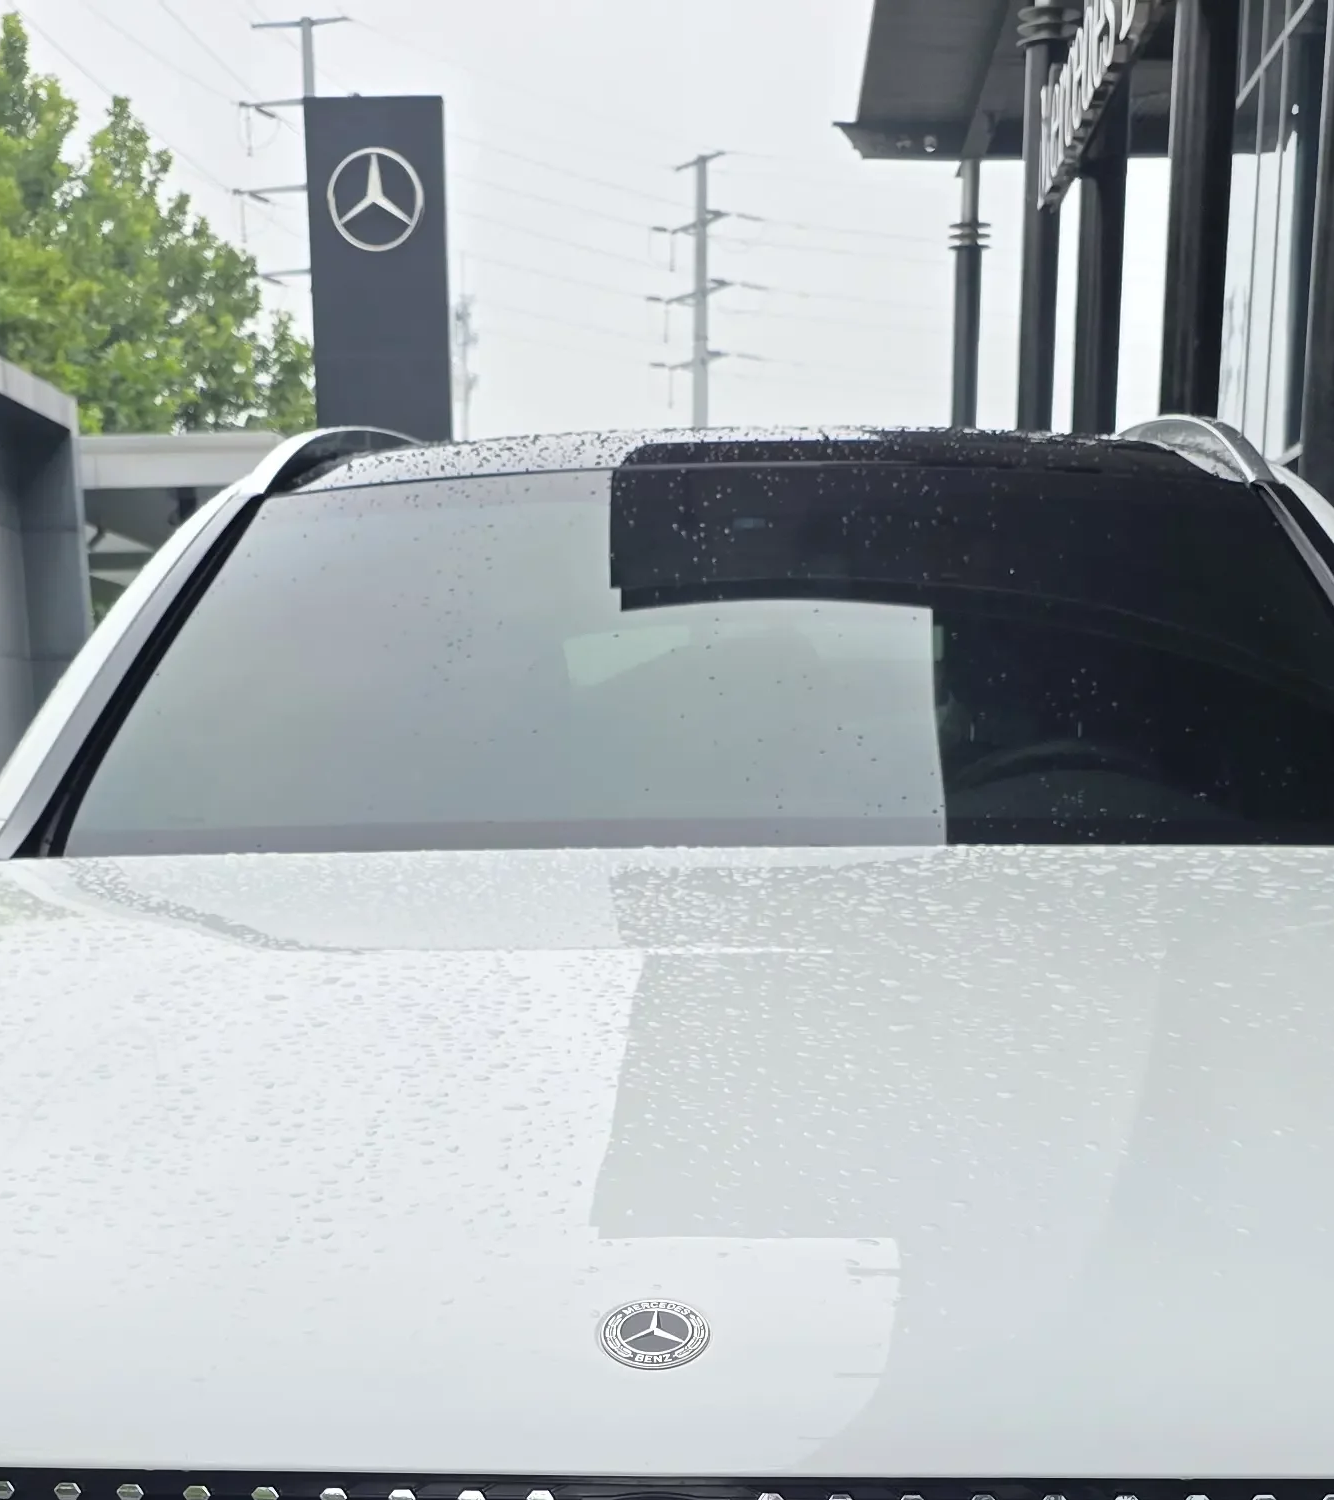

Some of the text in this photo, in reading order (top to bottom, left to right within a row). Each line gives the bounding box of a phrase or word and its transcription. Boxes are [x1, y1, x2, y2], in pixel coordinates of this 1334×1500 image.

[1036, 0, 1136, 211] Mercedes
[621, 1302, 692, 1316] MERCEDES
[634, 1353, 673, 1363] BENZ
